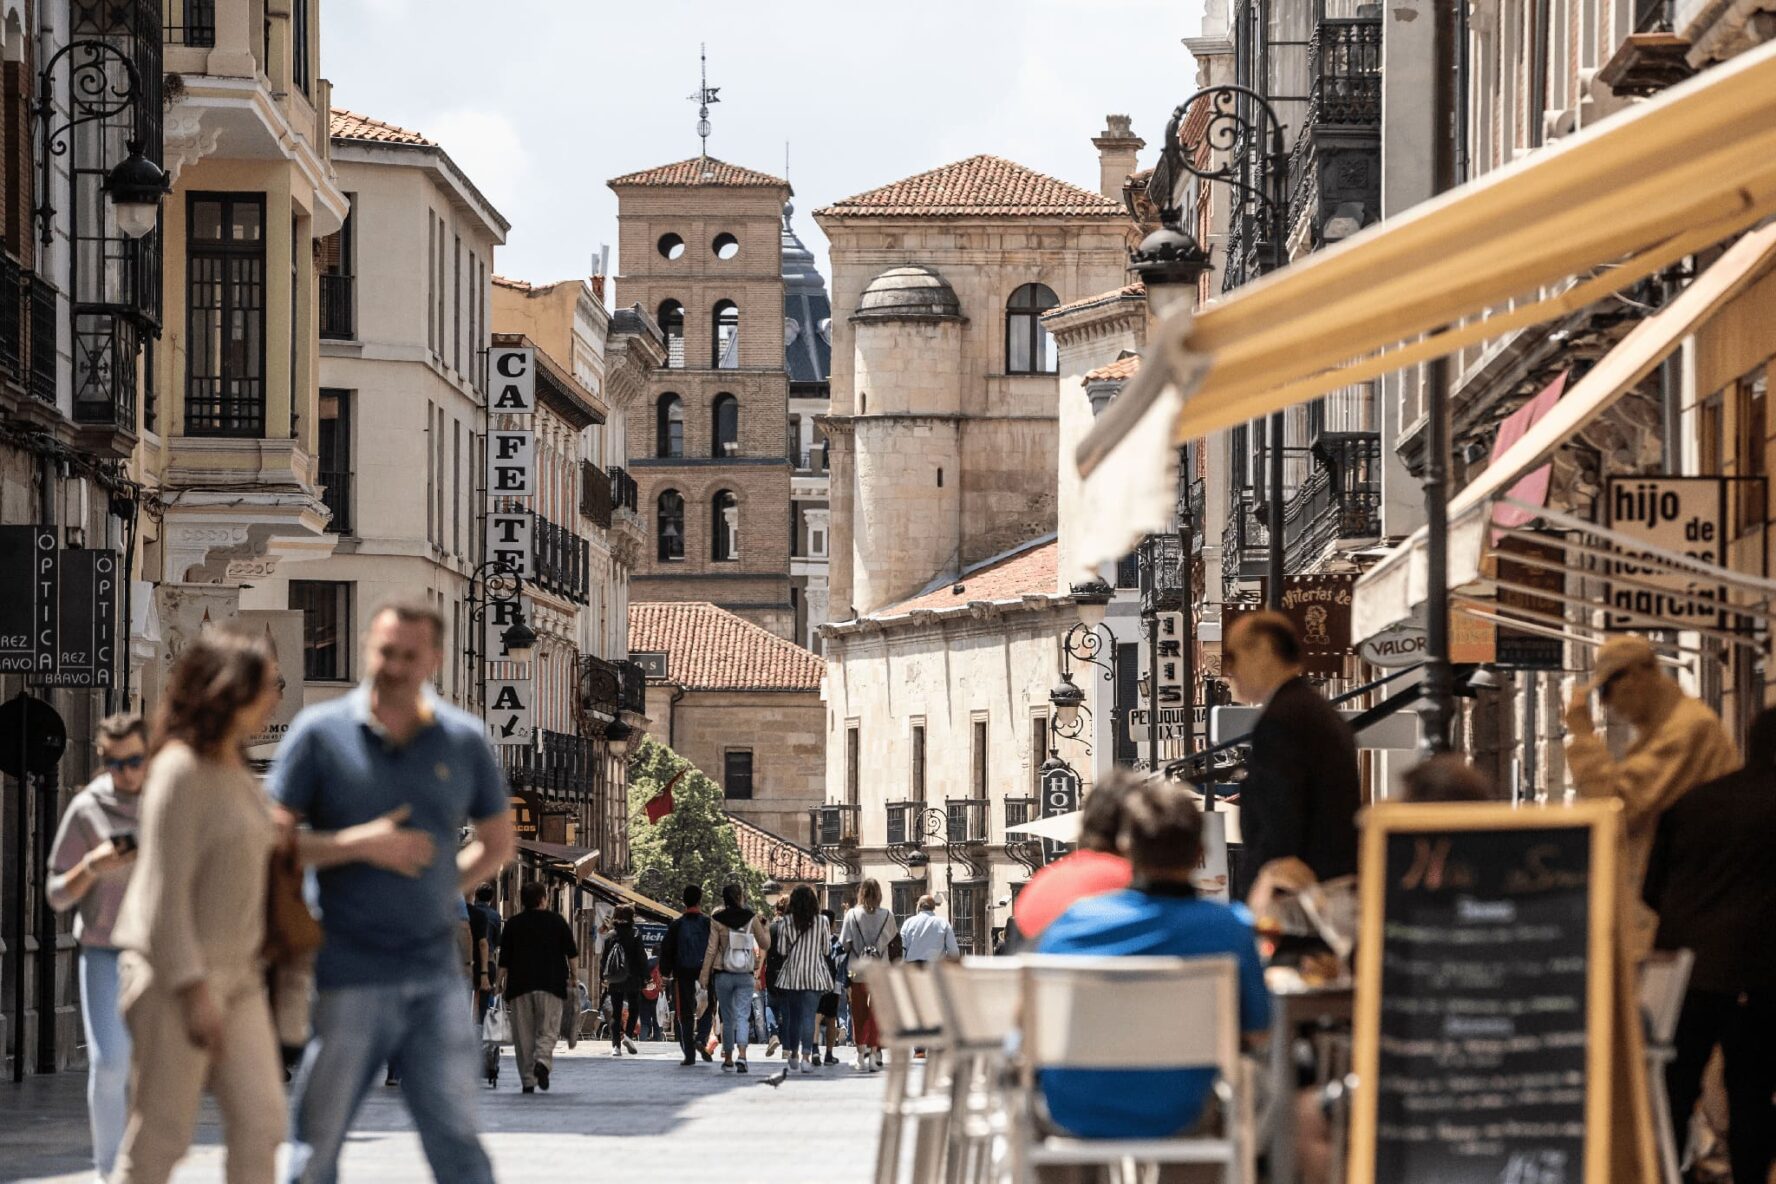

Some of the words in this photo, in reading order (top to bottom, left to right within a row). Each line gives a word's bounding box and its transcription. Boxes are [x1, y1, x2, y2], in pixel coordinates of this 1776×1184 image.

[1615, 483, 1679, 529] hijo
[1685, 516, 1714, 542] de
[38, 529, 55, 670] ÓPTICA
[96, 553, 113, 685] ÓPTICA
[0, 657, 33, 670] AVO
[1158, 617, 1181, 702] IRIS
[1370, 637, 1428, 656] VALOR
[45, 673, 91, 684] BRAVO
[1049, 776, 1071, 854] HOTL
